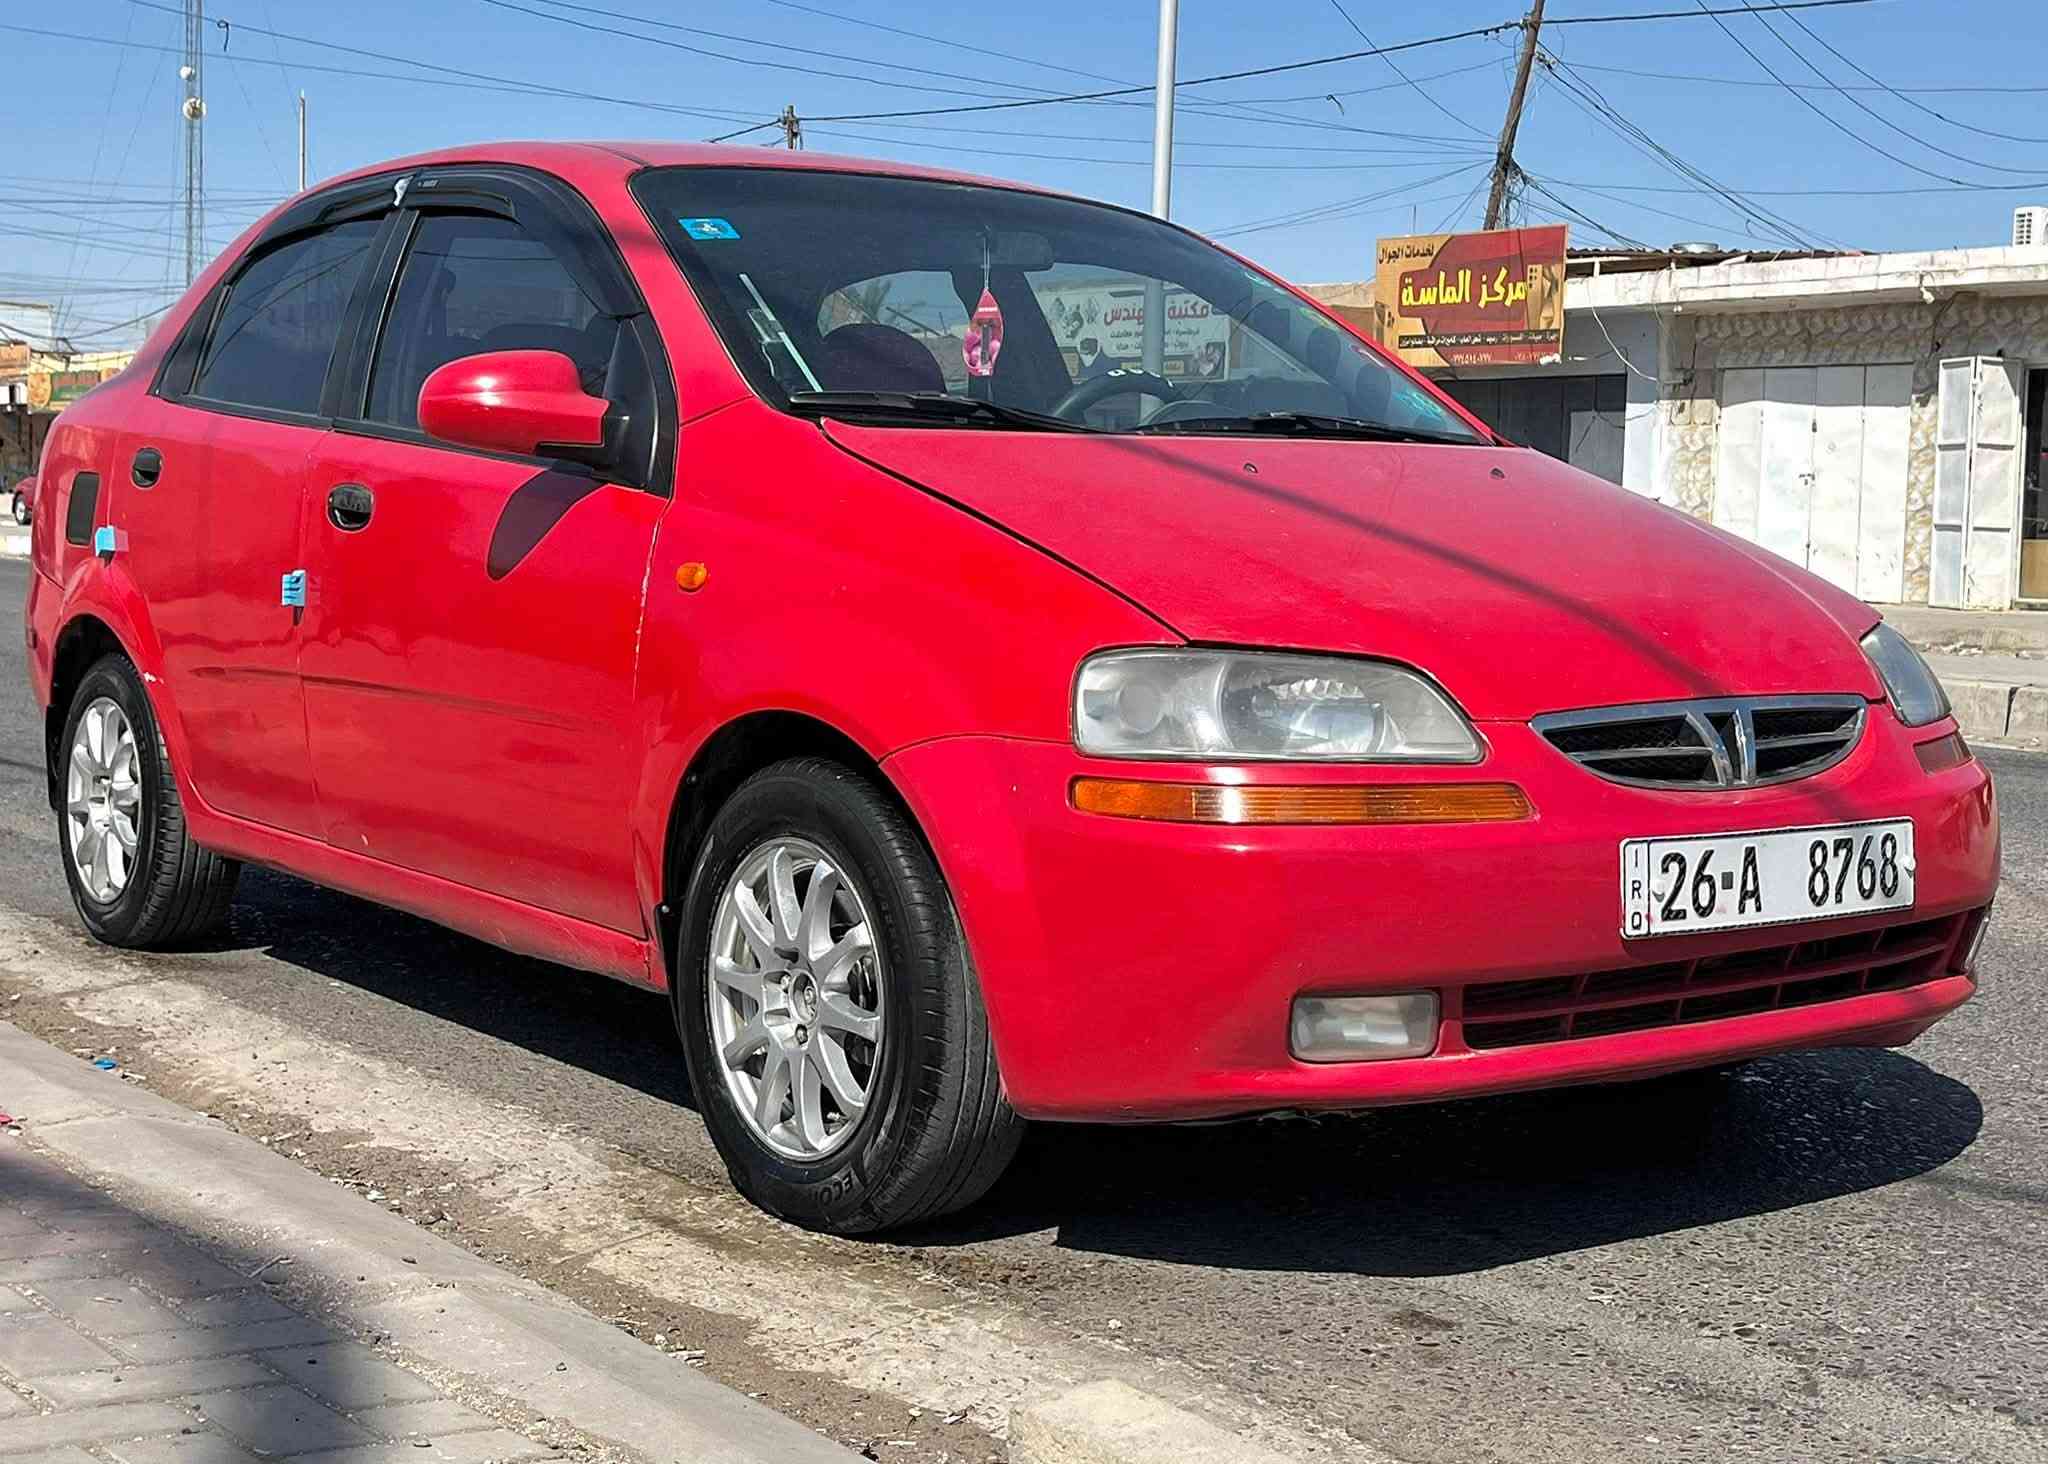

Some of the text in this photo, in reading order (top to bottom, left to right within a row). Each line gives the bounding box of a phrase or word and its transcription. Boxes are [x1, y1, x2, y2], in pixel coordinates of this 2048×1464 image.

[1378, 243, 1434, 264] لخدمات الجوال
[1401, 267, 1528, 309] مركز الماسة
[1167, 300, 1209, 320] مكتبة
[1630, 848, 1643, 930] IRQ
[1808, 832, 1899, 907] 8768
